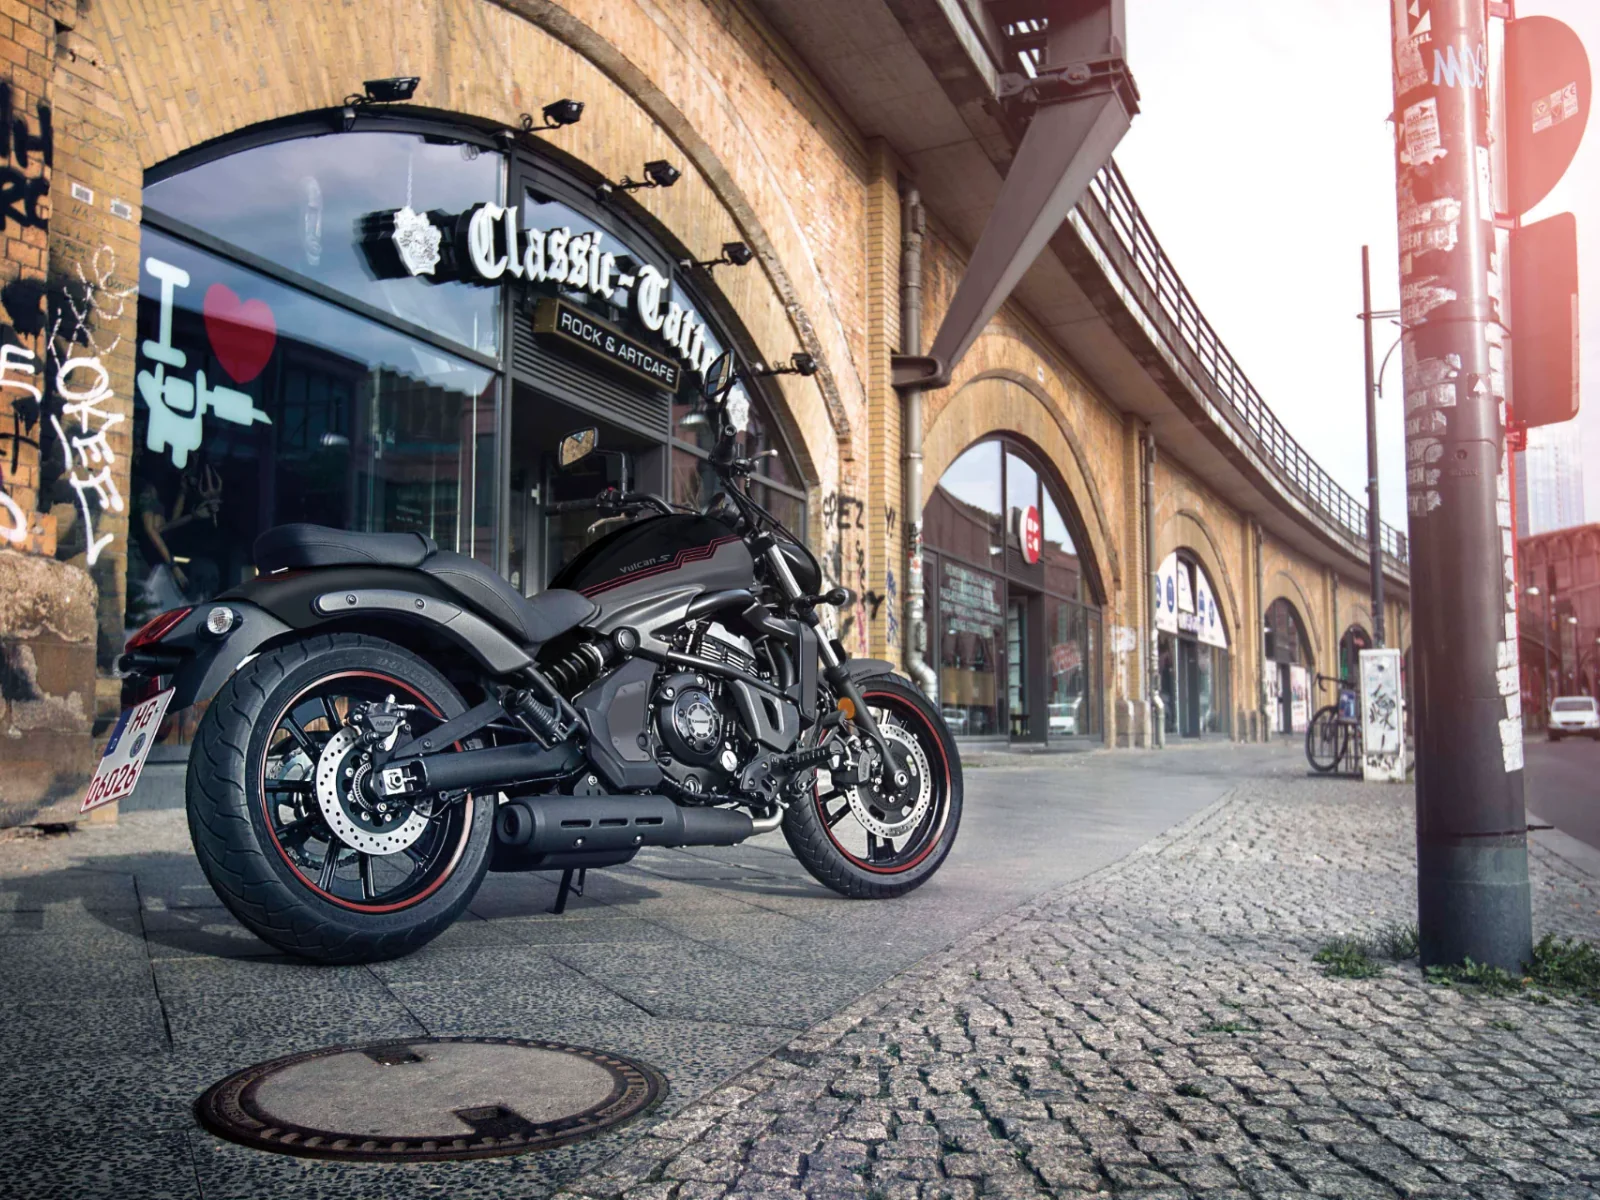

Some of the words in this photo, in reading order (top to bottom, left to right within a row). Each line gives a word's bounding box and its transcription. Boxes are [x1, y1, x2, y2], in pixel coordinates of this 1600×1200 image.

[560, 312, 602, 347] ROCK
[605, 336, 616, 353] &
[617, 342, 675, 383] ARTCAFE
[619, 558, 656, 574] Vulcan
[657, 554, 671, 563] S
[128, 700, 159, 734] HG
[85, 759, 139, 806] 06026
